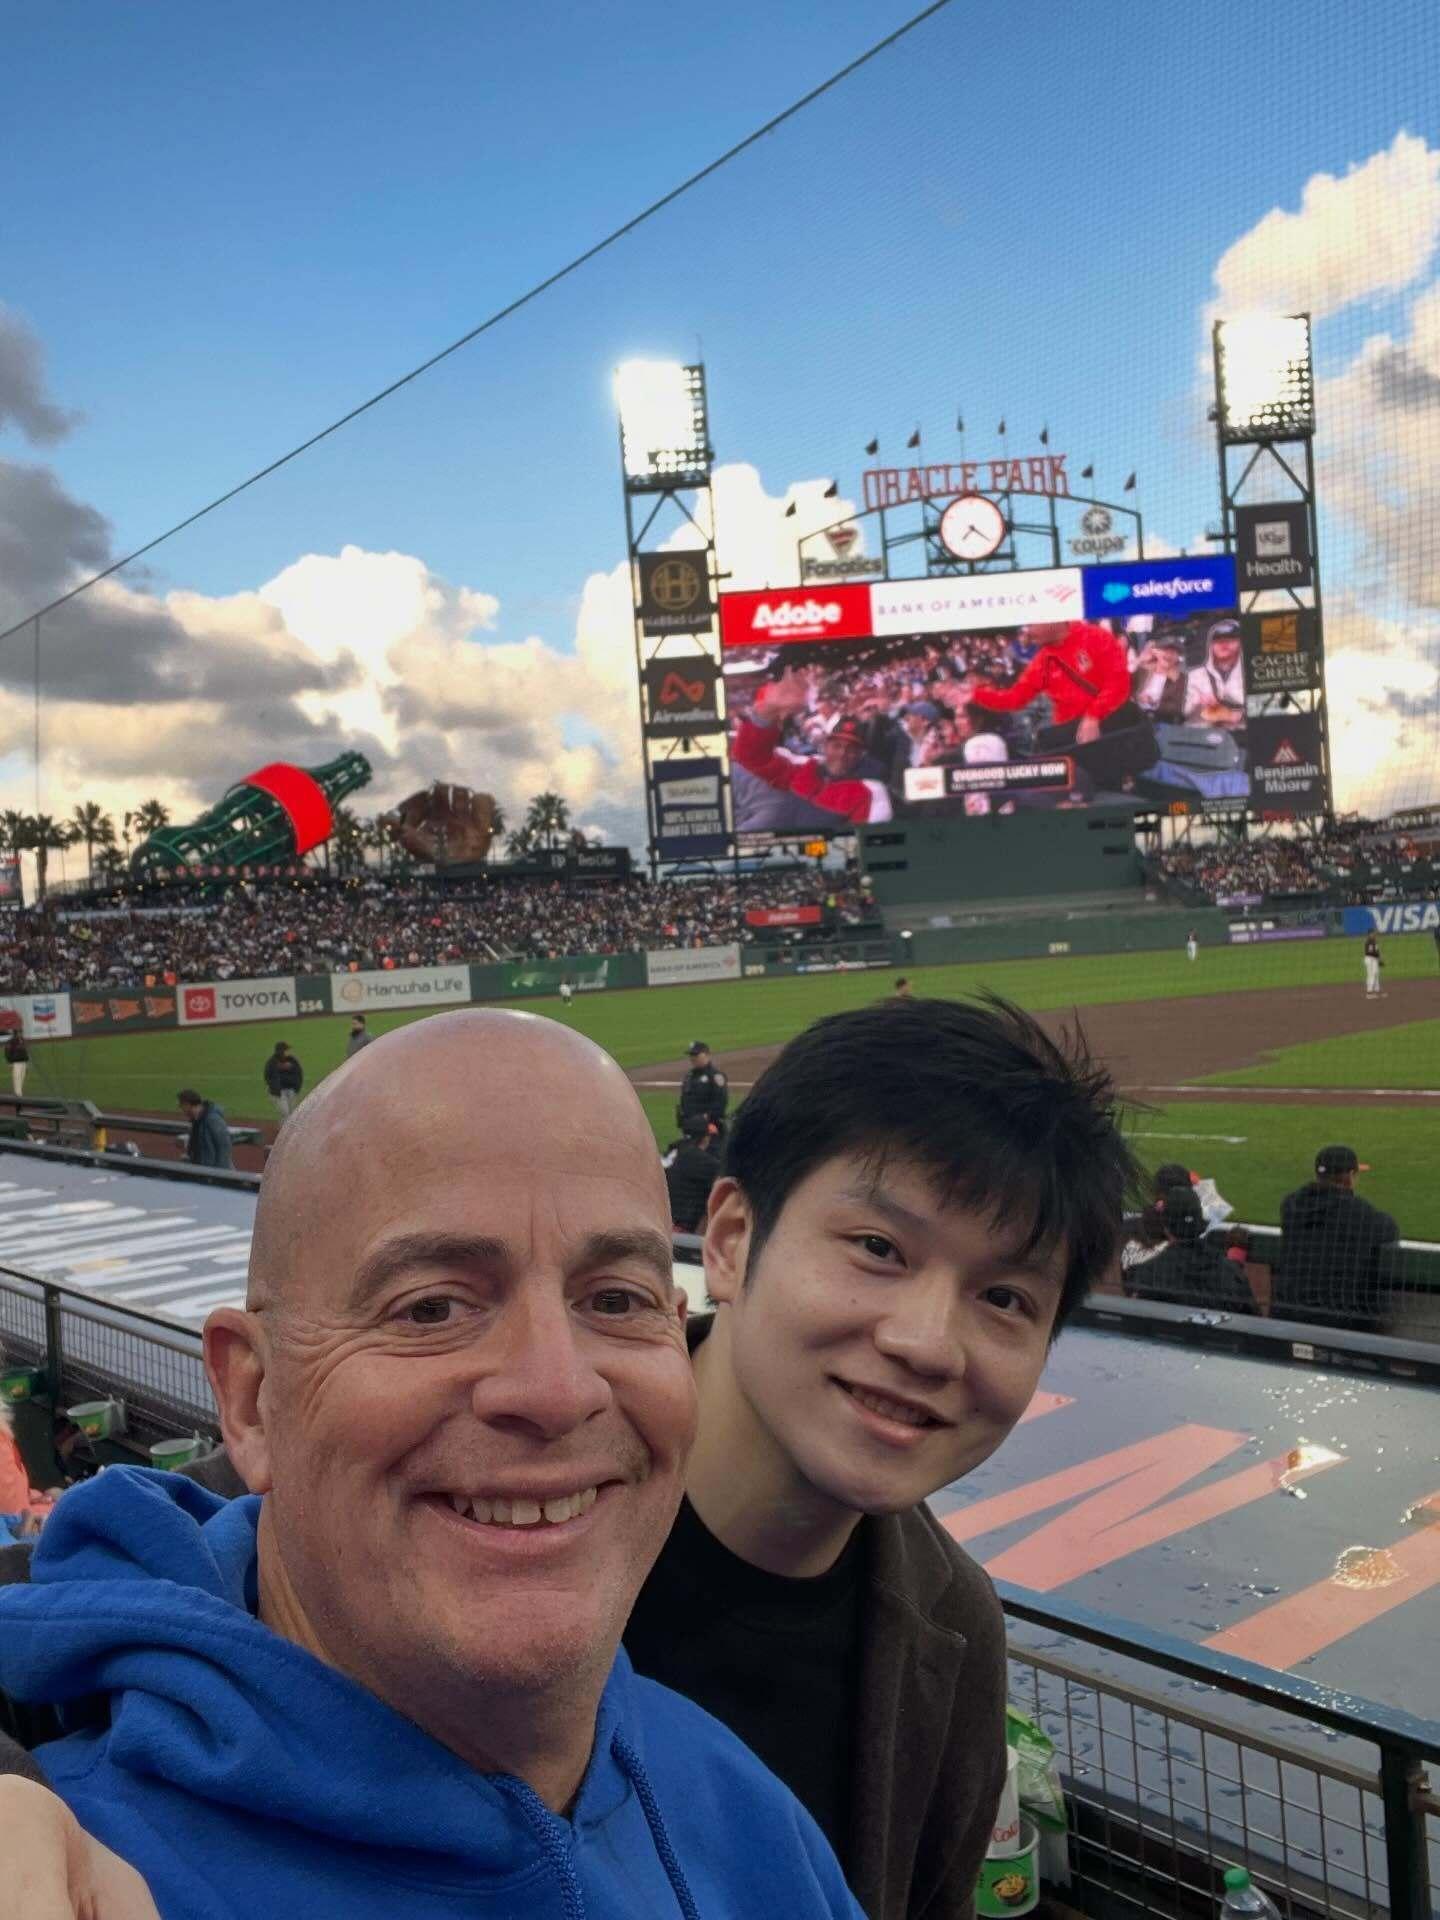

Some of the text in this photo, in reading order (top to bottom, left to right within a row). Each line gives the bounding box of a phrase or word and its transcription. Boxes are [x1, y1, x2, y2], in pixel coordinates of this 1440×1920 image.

[863, 454, 1070, 511] ORACLE PARK
[803, 555, 883, 578] Fanatics
[1246, 557, 1303, 577] Health
[1131, 576, 1214, 599] salesforce
[751, 600, 842, 629] Adobe
[877, 592, 1038, 616] BANK OF AMERICA
[1006, 764, 1039, 779] LUCKY
[1254, 761, 1320, 780] Benjamin
[1265, 779, 1312, 793] Moore
[1367, 904, 1440, 933] VISA
[367, 977, 464, 997] Hanwha Life
[222, 991, 290, 1008] TOYOTA
